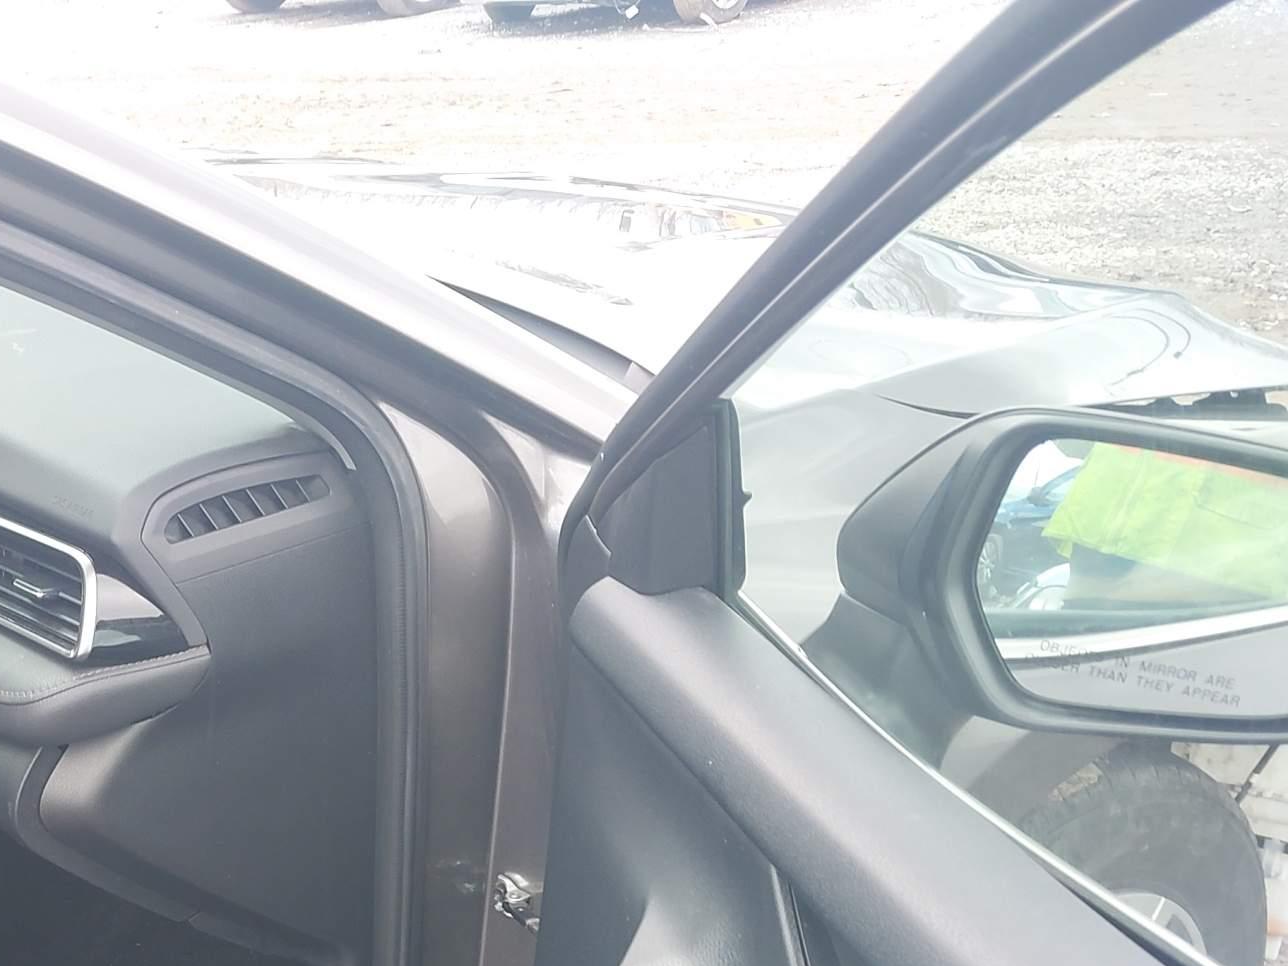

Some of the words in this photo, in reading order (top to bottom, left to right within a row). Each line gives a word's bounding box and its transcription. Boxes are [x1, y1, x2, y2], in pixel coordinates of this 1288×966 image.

[1089, 665, 1128, 684] THAN
[1136, 675, 1174, 692] THEY
[1181, 685, 1241, 708] APPEAR
[1114, 655, 1130, 668] IN
[1139, 660, 1197, 681] MIRROR
[1205, 674, 1237, 689] ARE
